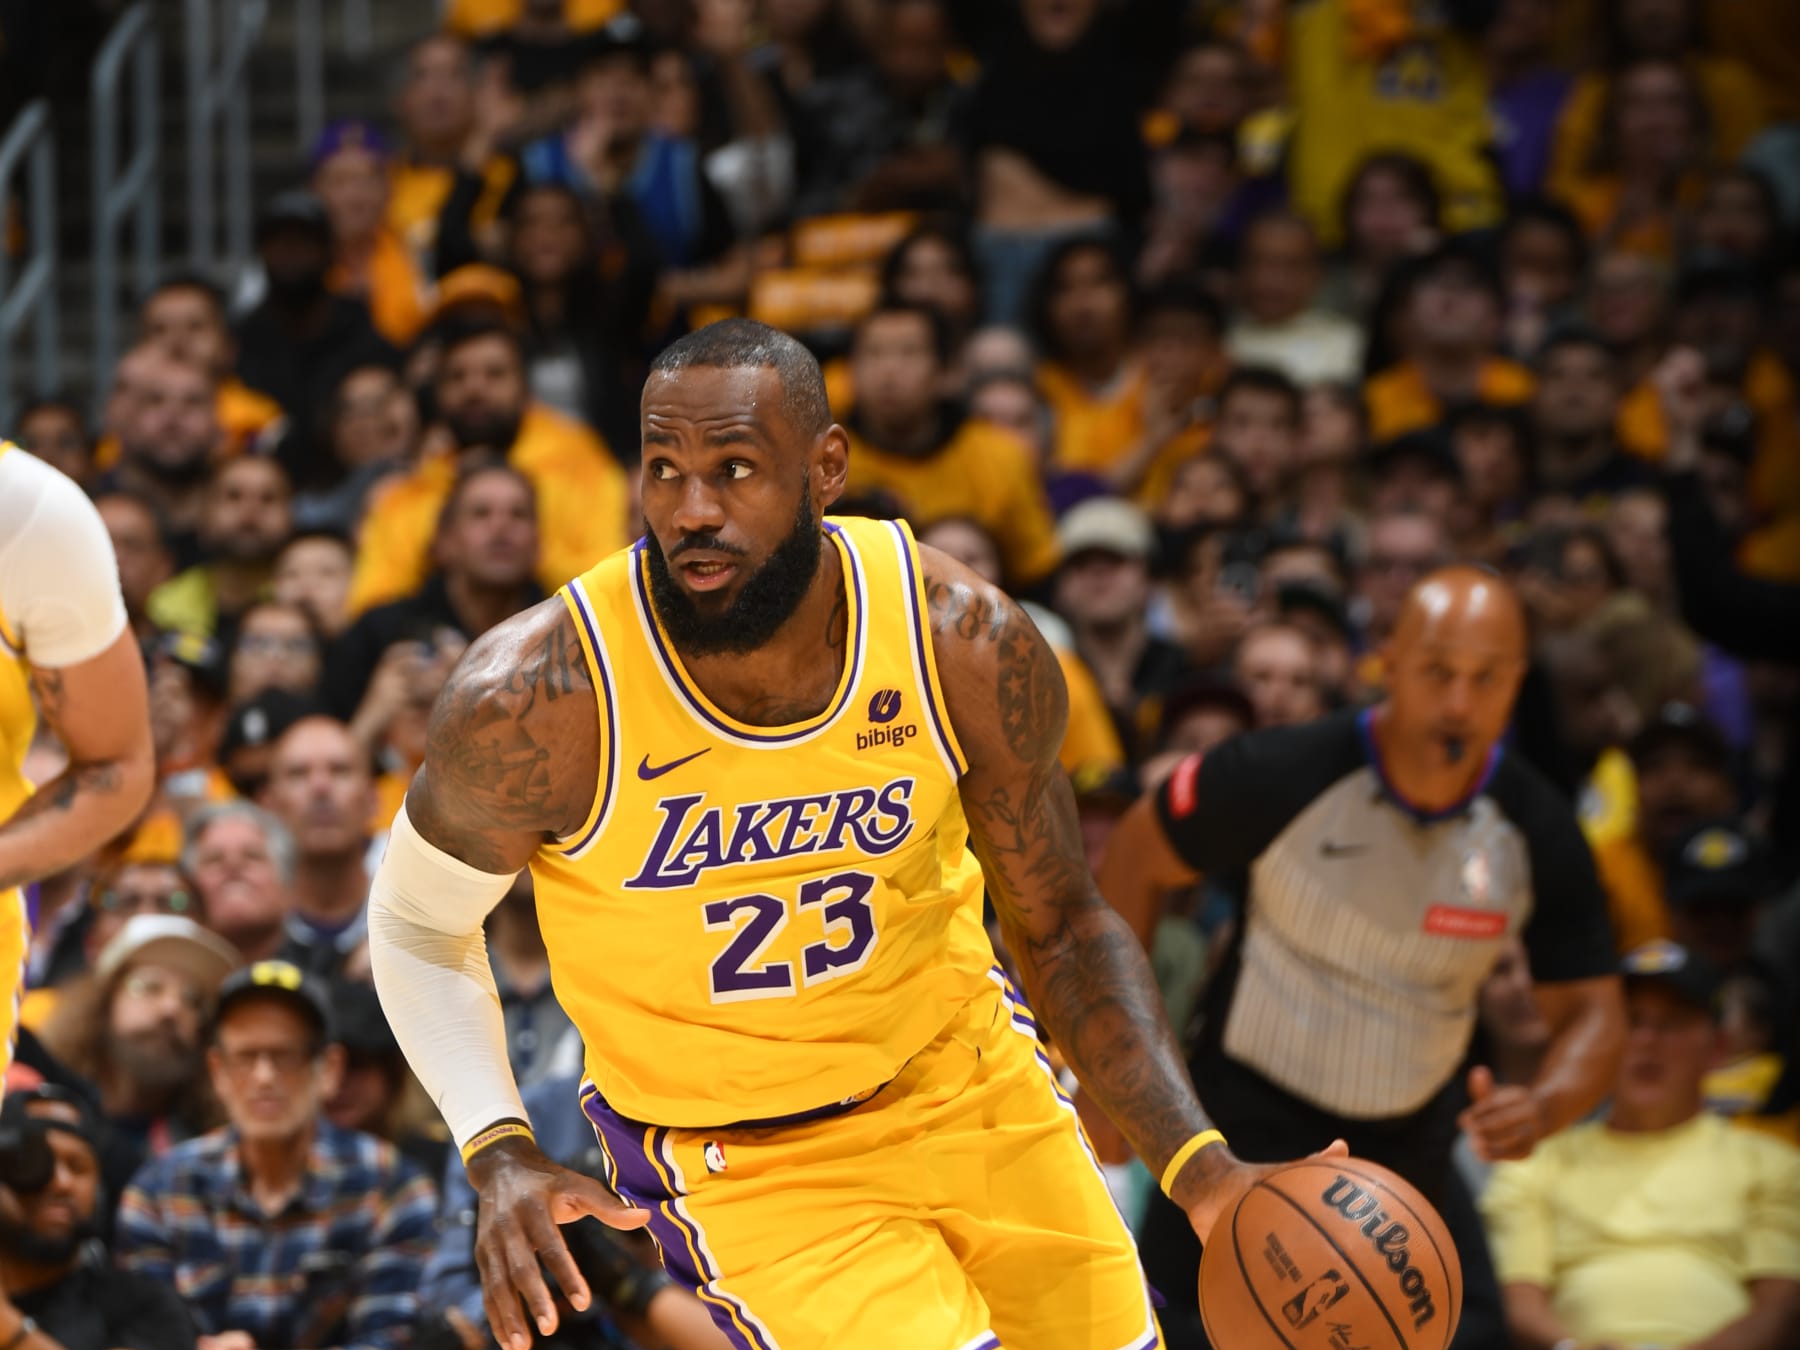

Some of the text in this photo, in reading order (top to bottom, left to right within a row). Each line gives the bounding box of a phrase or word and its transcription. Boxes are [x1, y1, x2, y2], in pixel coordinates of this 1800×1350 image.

[855, 721, 918, 752] bibigo
[621, 776, 917, 891] LAKERS
[700, 869, 880, 1006] 23
[1321, 1174, 1436, 1333] Wilson
